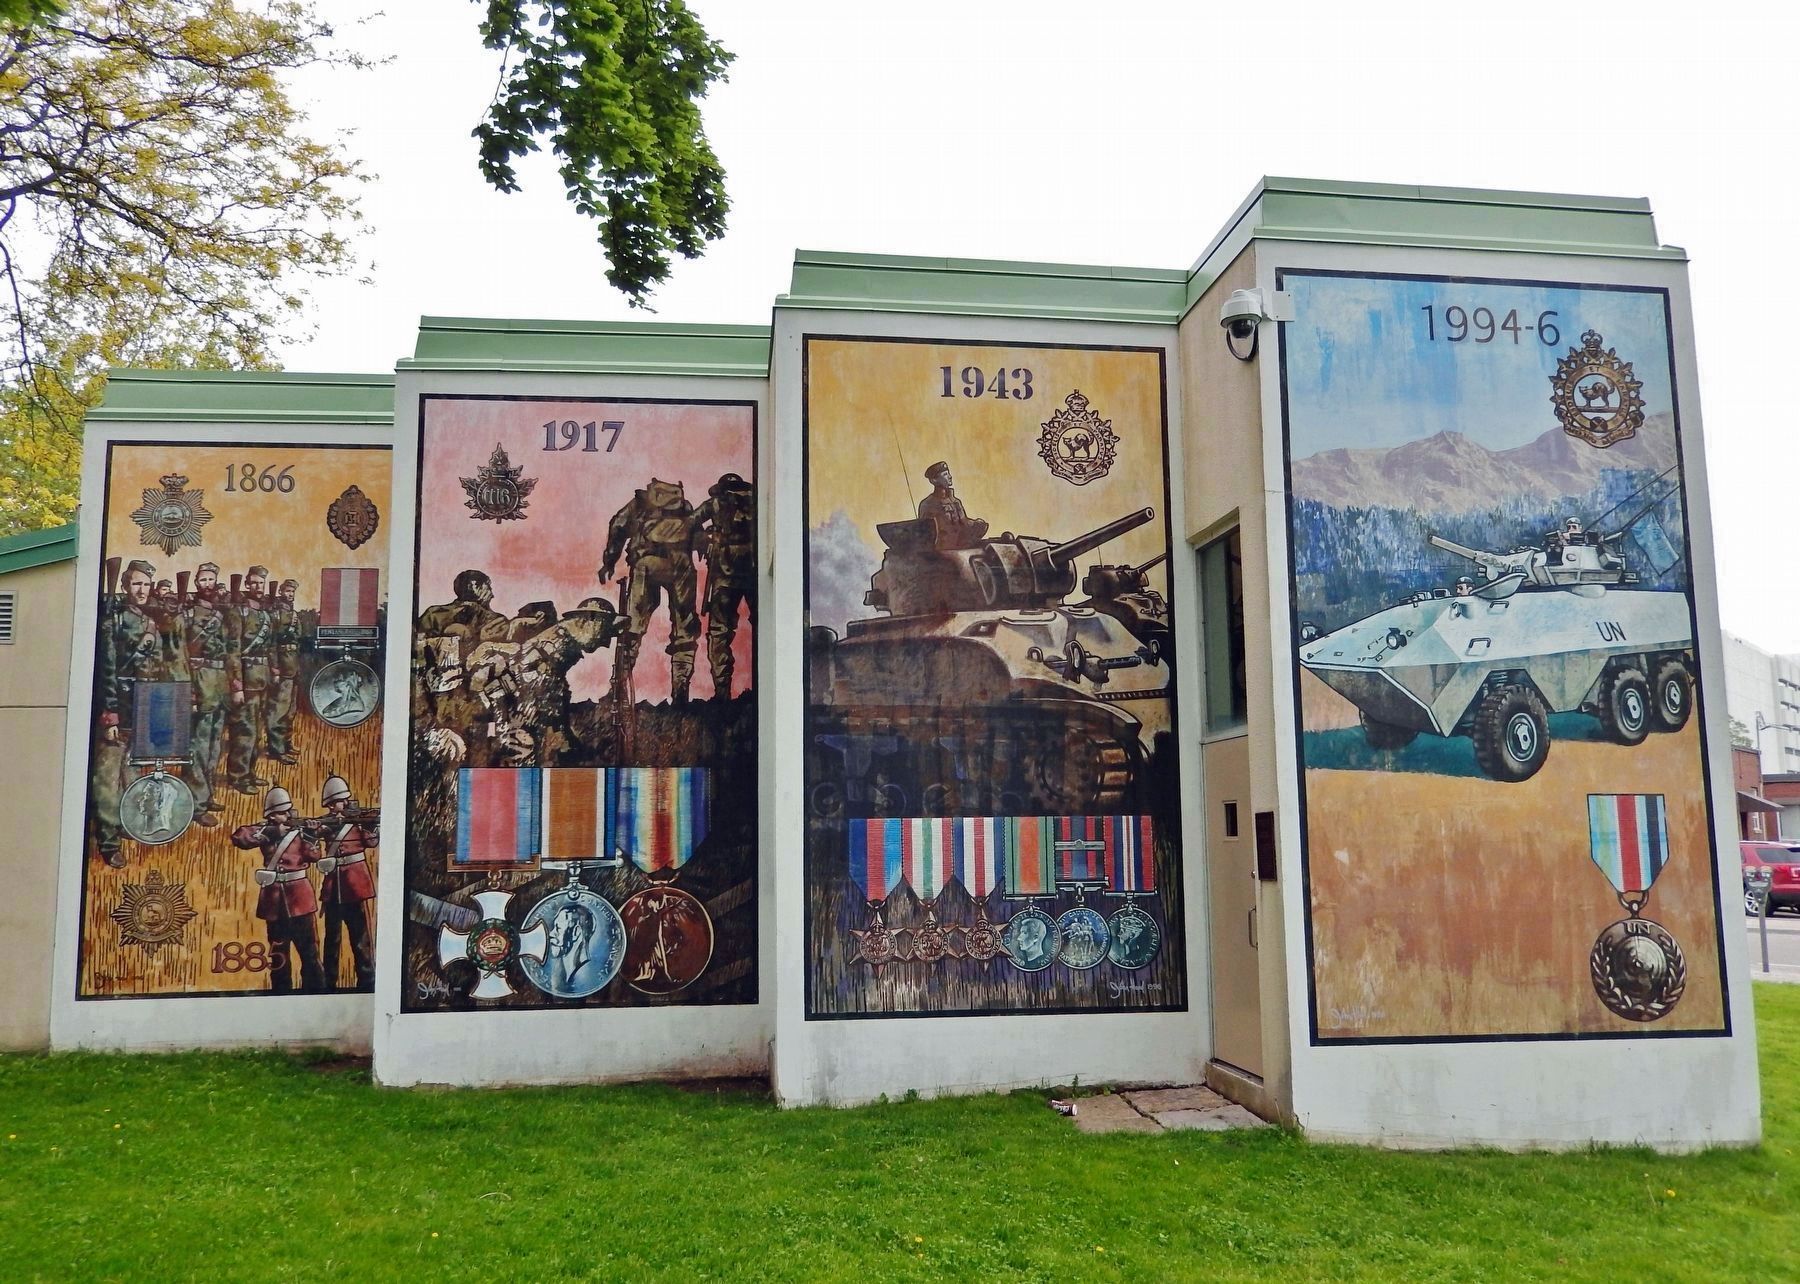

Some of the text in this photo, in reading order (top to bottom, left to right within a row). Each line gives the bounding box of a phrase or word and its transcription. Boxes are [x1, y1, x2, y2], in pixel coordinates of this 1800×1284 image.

[1421, 304, 1560, 347] 1994-6
[939, 366, 1034, 400] 1943
[542, 420, 625, 453] 1917
[224, 462, 296, 493] 1866
[1595, 621, 1627, 642] UN
[1626, 922, 1650, 934] UN
[211, 942, 286, 974] 1885
